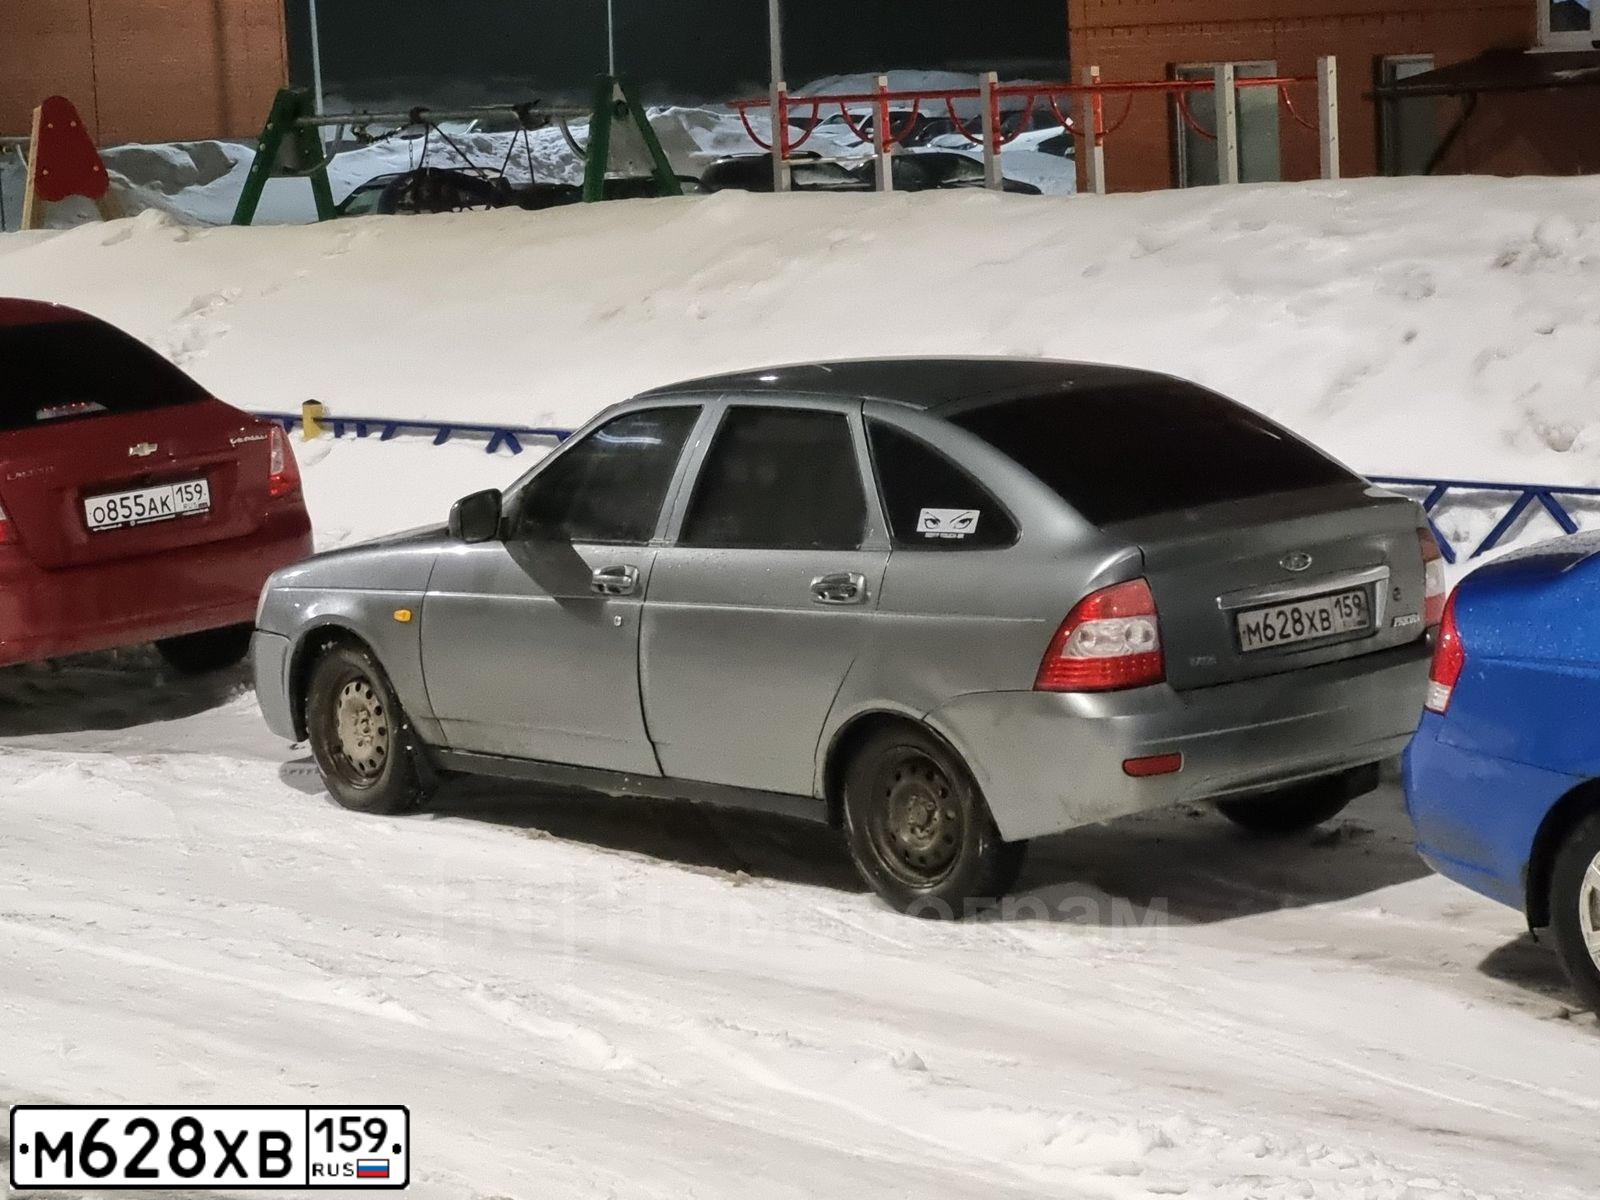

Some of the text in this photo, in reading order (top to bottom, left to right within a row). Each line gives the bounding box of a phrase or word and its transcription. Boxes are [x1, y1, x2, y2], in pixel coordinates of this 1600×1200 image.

[93, 483, 203, 523] О855АК 159
[1246, 594, 1361, 646] М628ХВ 159
